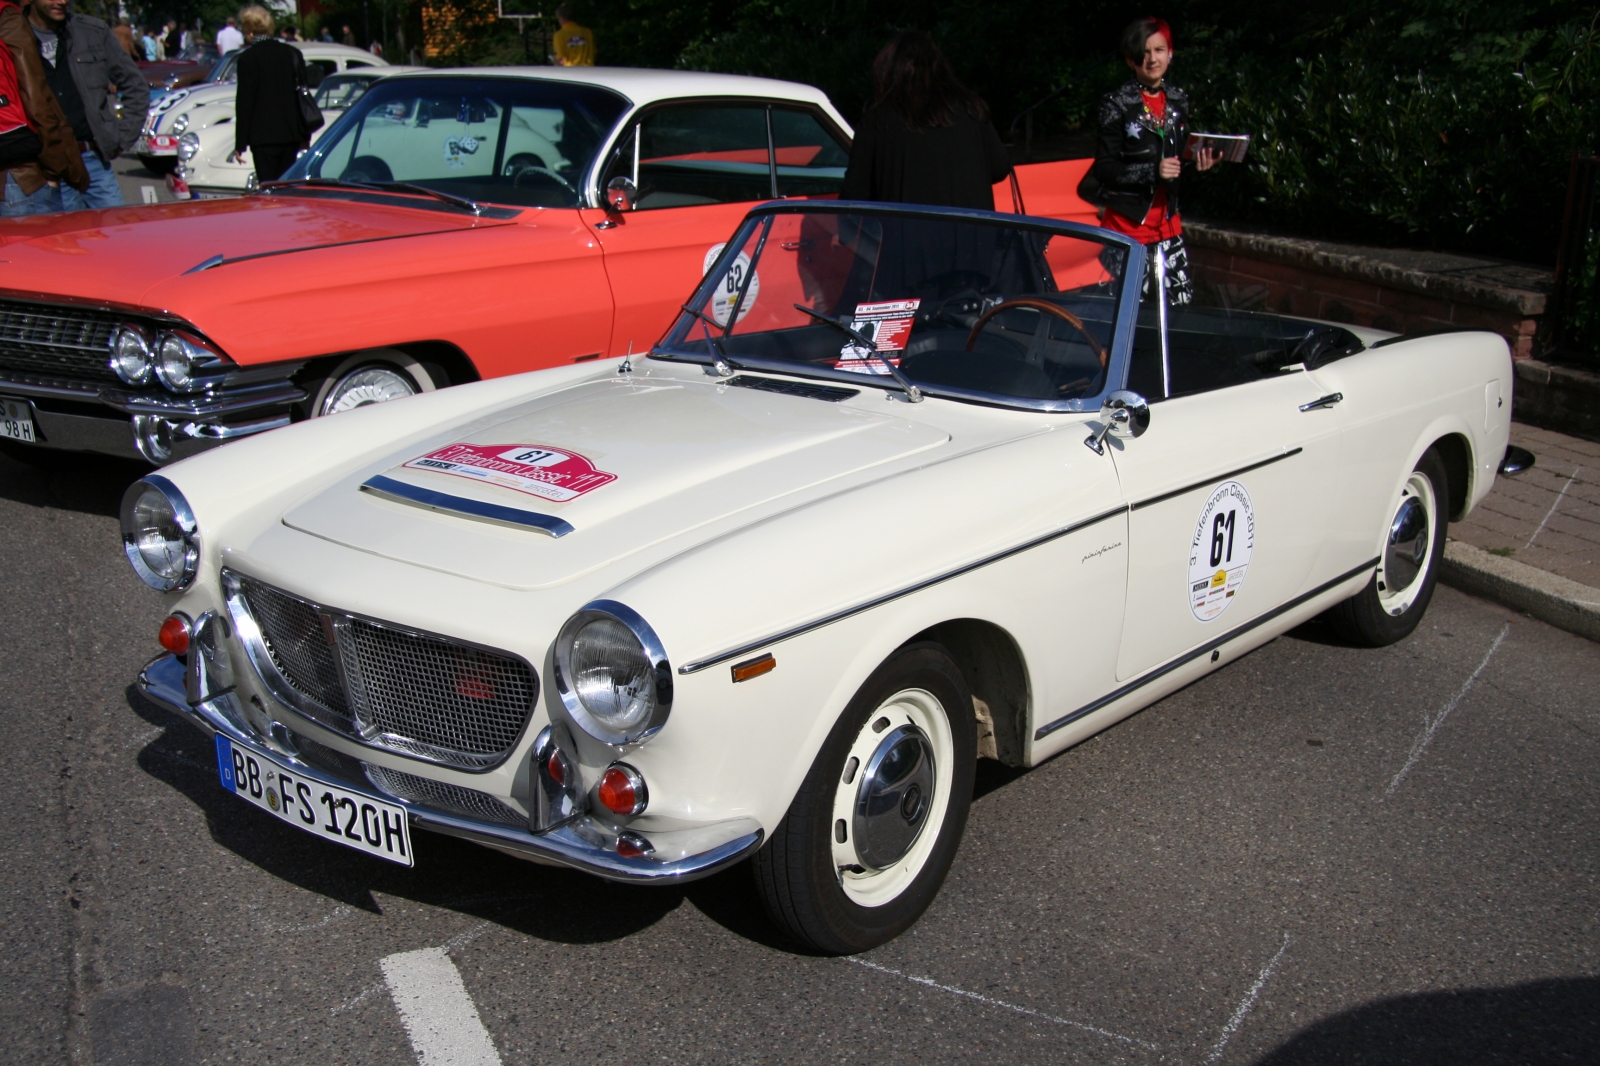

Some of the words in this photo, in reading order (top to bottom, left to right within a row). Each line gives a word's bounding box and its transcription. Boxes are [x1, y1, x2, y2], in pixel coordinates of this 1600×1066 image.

[727, 264, 742, 293] 62
[5, 420, 20, 437] 98
[443, 448, 520, 474] Tiefenbronn
[515, 465, 571, 484] Classic
[514, 450, 553, 463] 61
[1192, 488, 1229, 548] Tiefenbronn
[1230, 484, 1250, 513] Classic
[1210, 509, 1236, 567] 61
[225, 768, 231, 780] D
[232, 747, 263, 799] BB
[279, 773, 316, 825] FS
[321, 791, 407, 857] 120H
